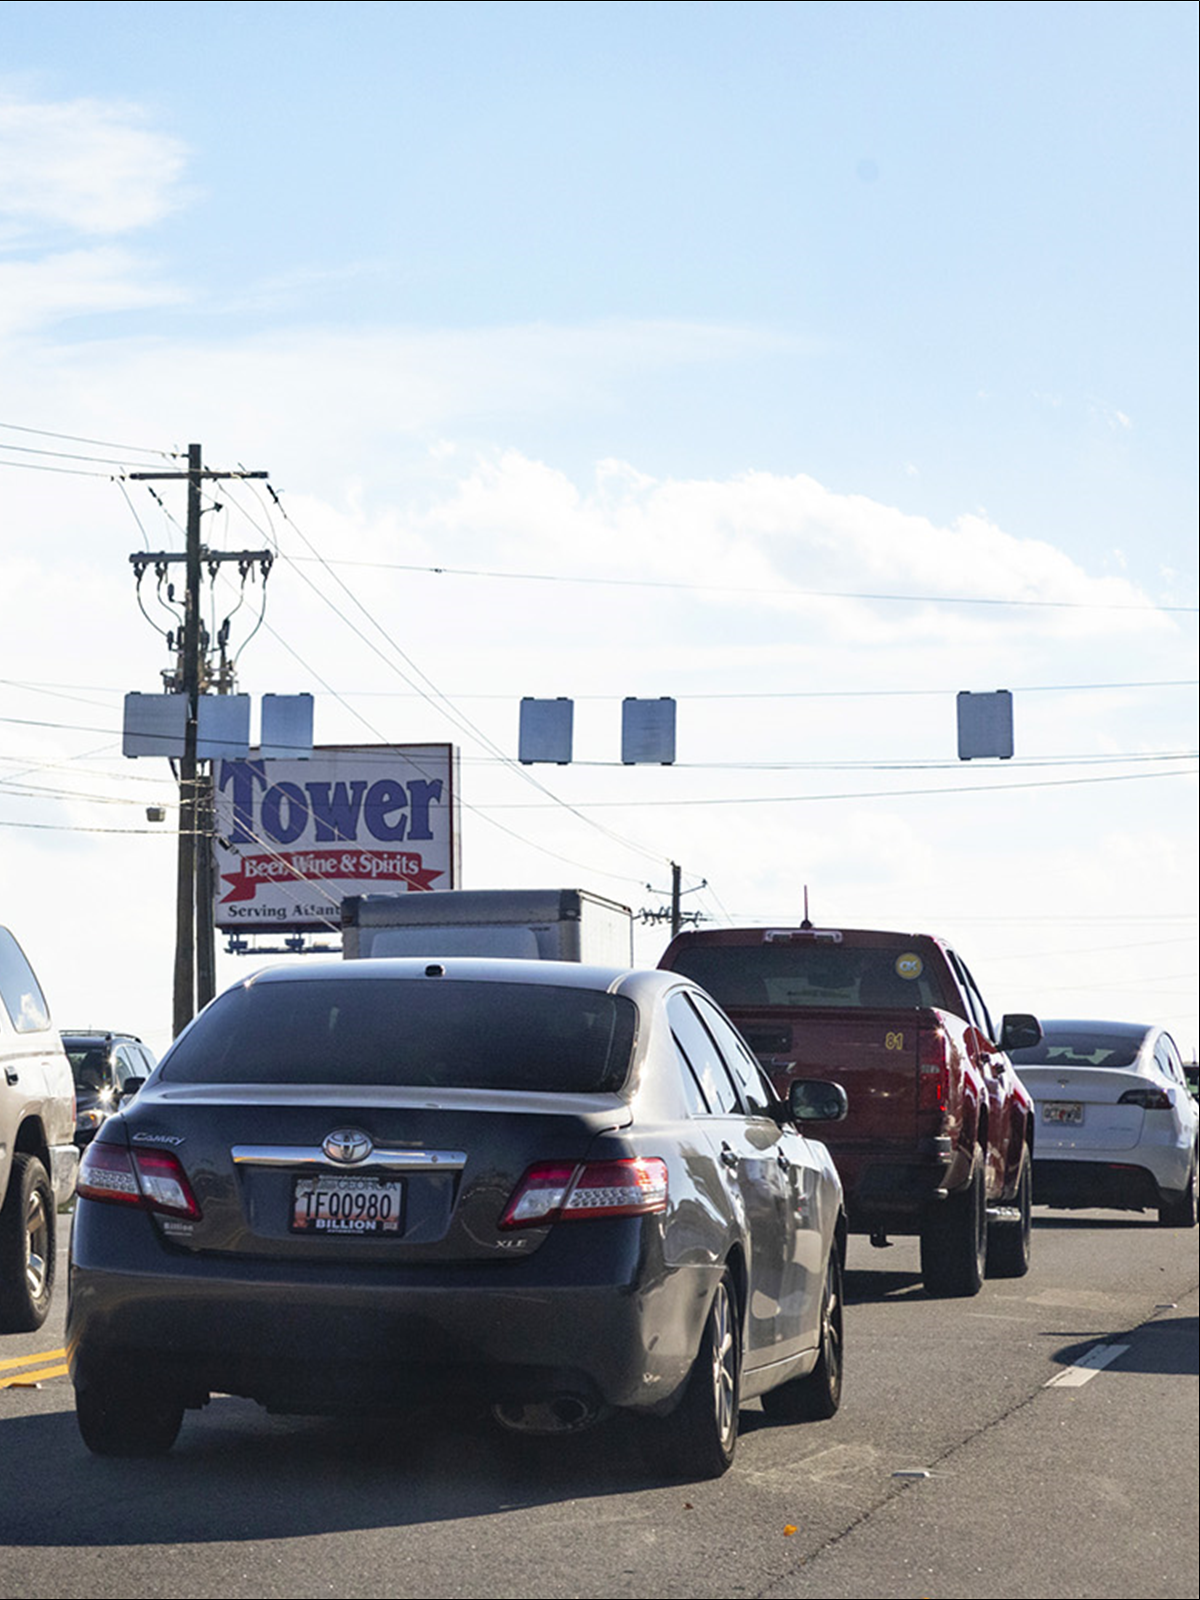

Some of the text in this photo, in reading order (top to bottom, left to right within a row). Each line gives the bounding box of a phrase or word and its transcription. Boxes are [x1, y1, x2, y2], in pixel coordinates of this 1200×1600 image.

[218, 758, 444, 845] Tower
[292, 854, 337, 873] Wine
[340, 853, 357, 872] &
[359, 853, 420, 877] Spirits
[228, 904, 341, 920] Serving Atlant
[899, 960, 918, 971] OK
[885, 1031, 903, 1050] 81
[304, 1191, 392, 1220] TFQ0980
[315, 1219, 377, 1230] BILLION
